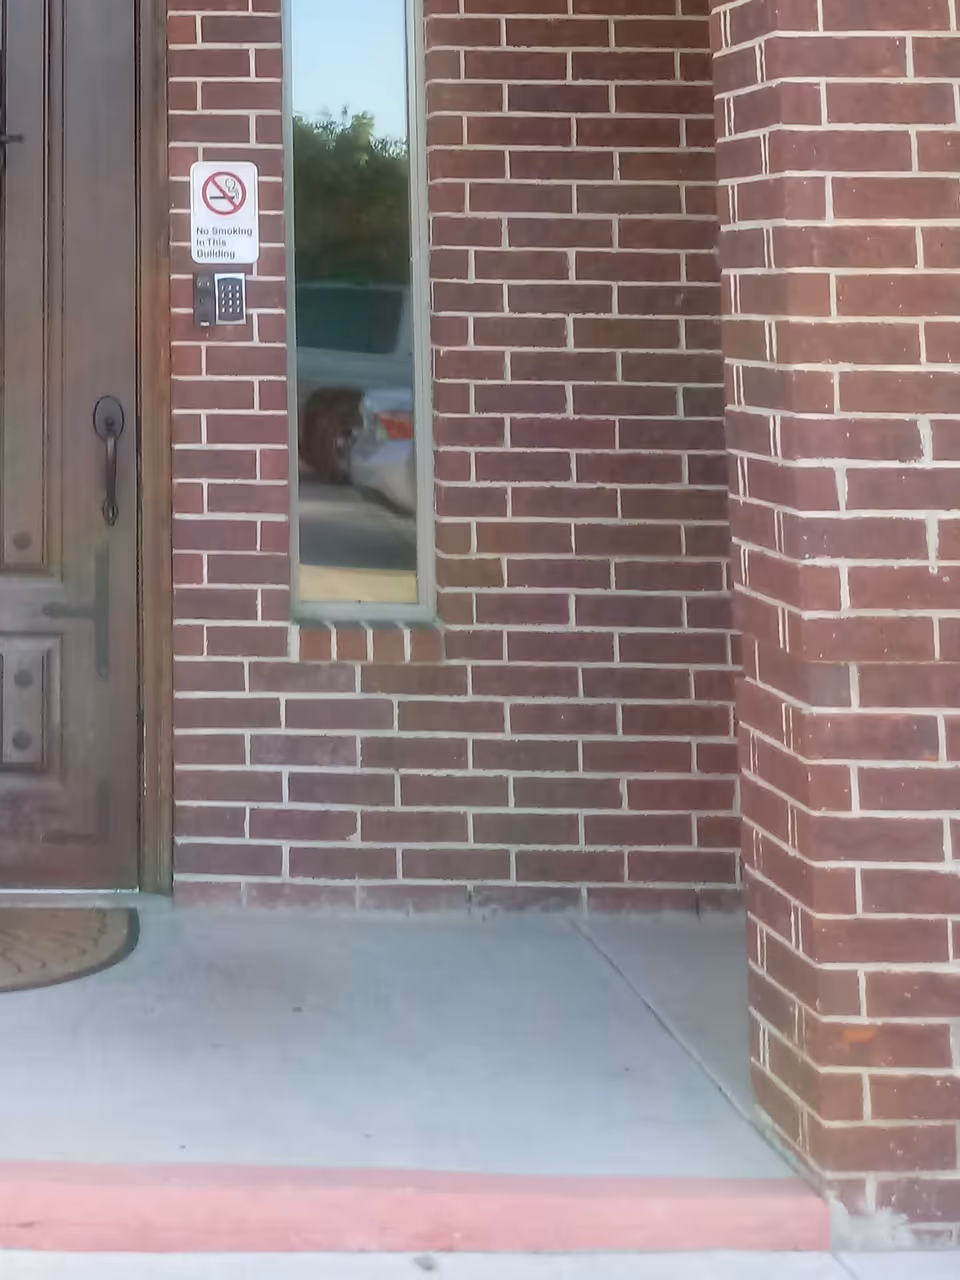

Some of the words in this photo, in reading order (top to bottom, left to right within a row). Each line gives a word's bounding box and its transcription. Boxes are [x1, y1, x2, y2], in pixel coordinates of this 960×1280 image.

[196, 226, 209, 235] No
[212, 226, 253, 237] Smoking
[196, 237, 205, 247] In
[207, 237, 227, 247] This
[196, 249, 236, 260] Building
